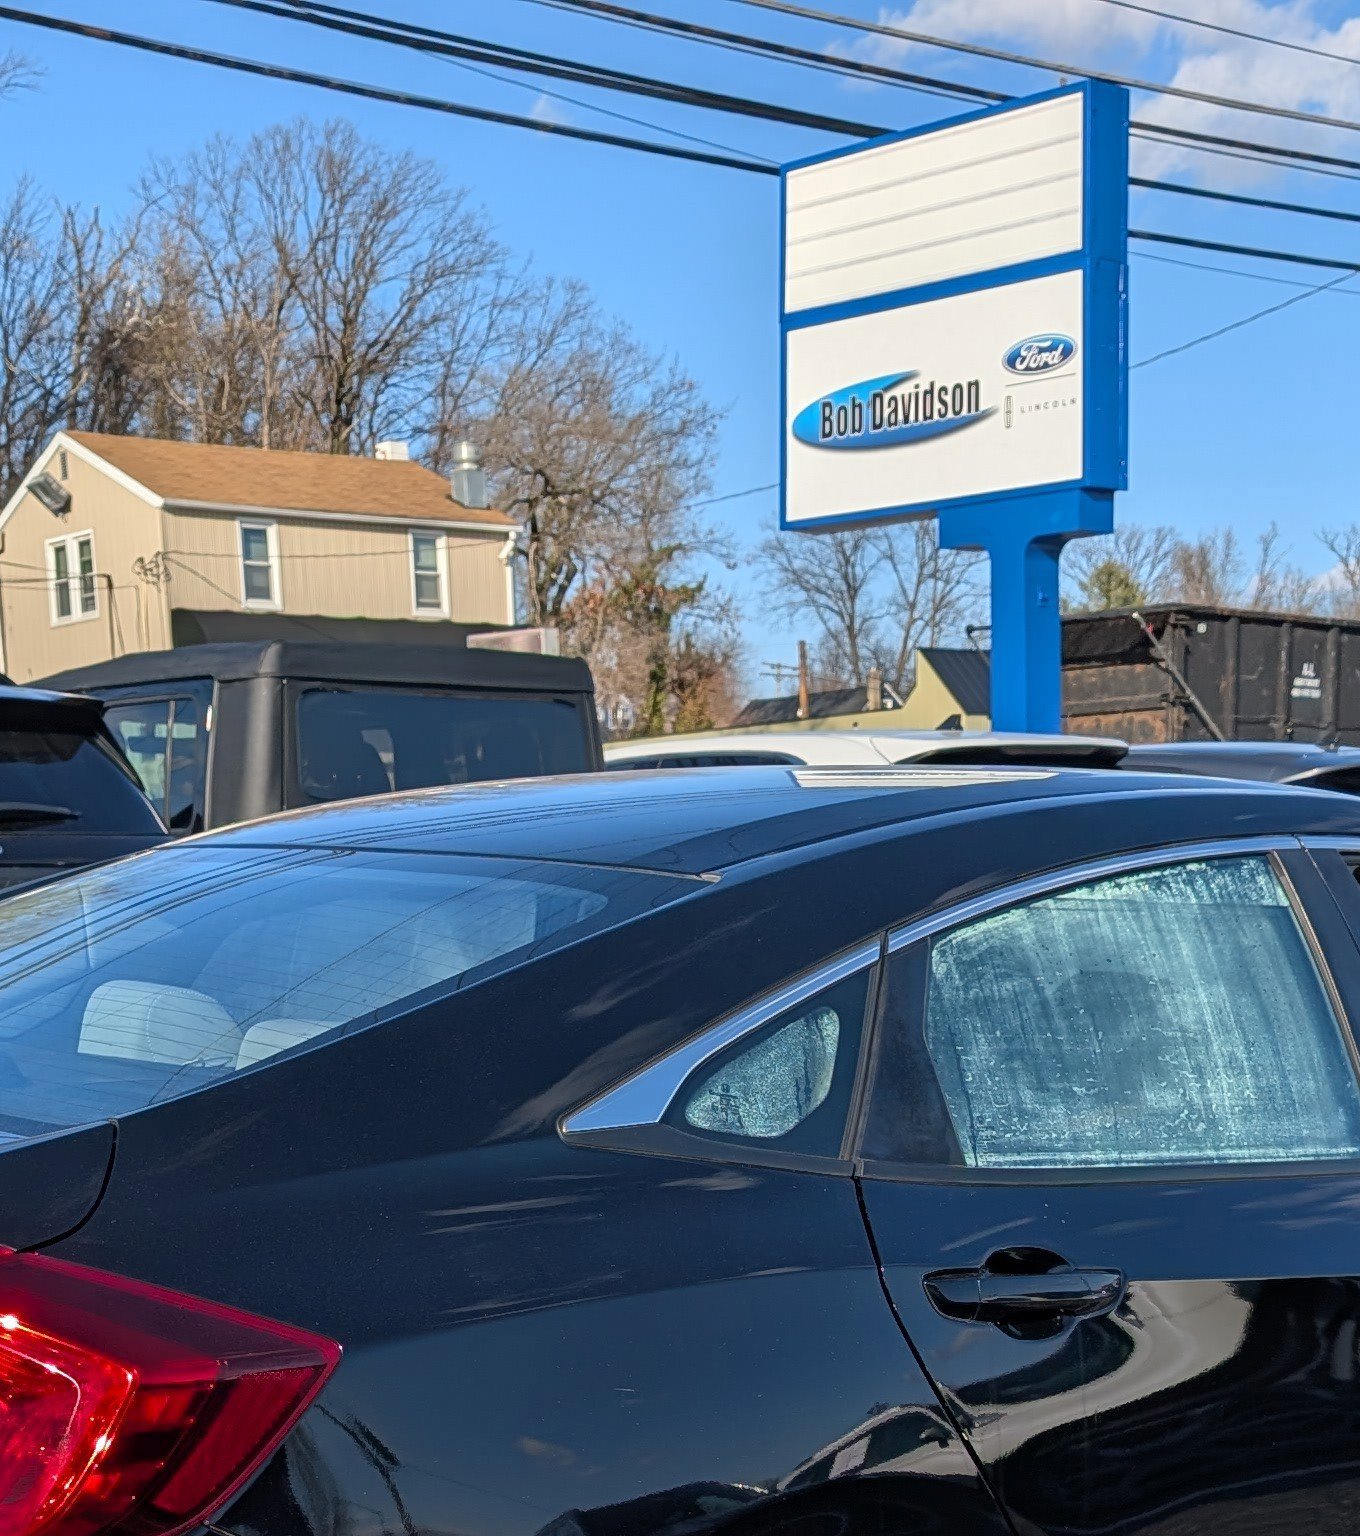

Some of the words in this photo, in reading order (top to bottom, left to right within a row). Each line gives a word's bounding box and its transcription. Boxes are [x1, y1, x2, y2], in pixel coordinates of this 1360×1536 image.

[1014, 339, 1065, 371] Ford
[820, 396, 863, 440] Bob
[870, 378, 981, 432] Davidson
[1020, 397, 1077, 413] LINCOLN
